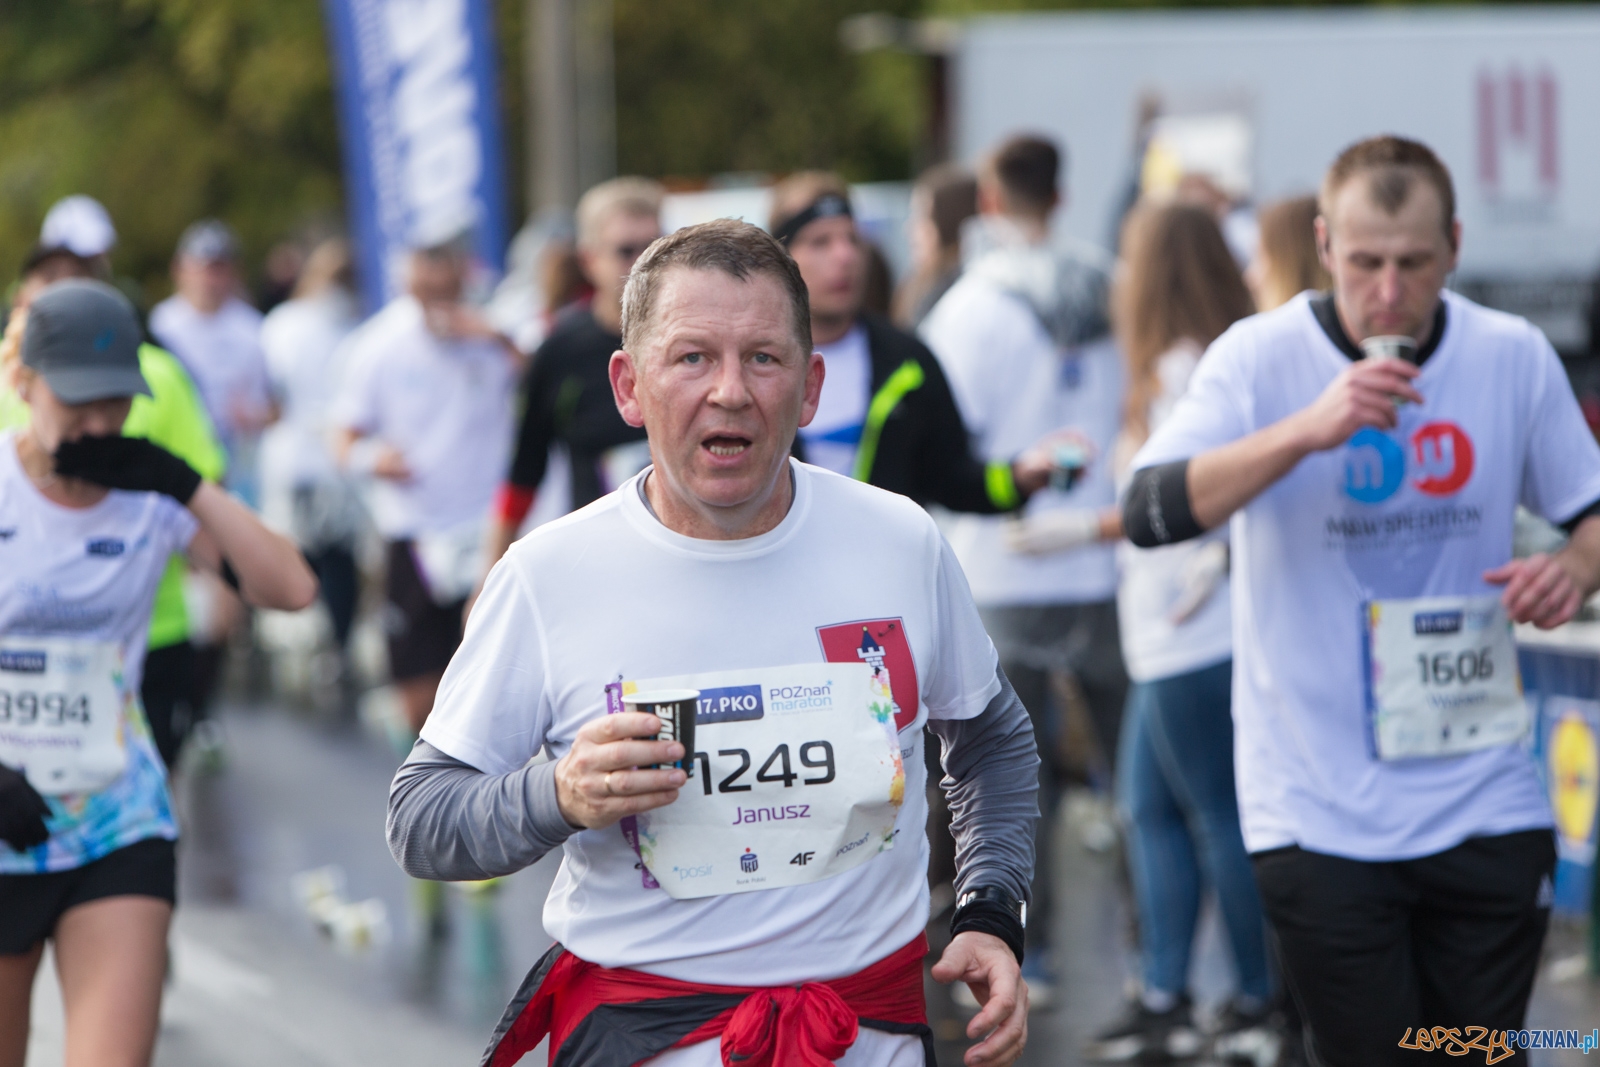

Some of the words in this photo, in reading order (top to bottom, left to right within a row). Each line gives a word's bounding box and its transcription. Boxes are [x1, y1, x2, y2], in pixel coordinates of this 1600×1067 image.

[1417, 646, 1495, 687] 1606
[696, 698, 718, 715] 17.
[719, 694, 758, 713] PKO
[771, 695, 833, 712] maraton
[694, 739, 836, 796] 1249
[732, 804, 811, 825] Janusz
[789, 851, 816, 866] 4F
[679, 864, 714, 880] posir
